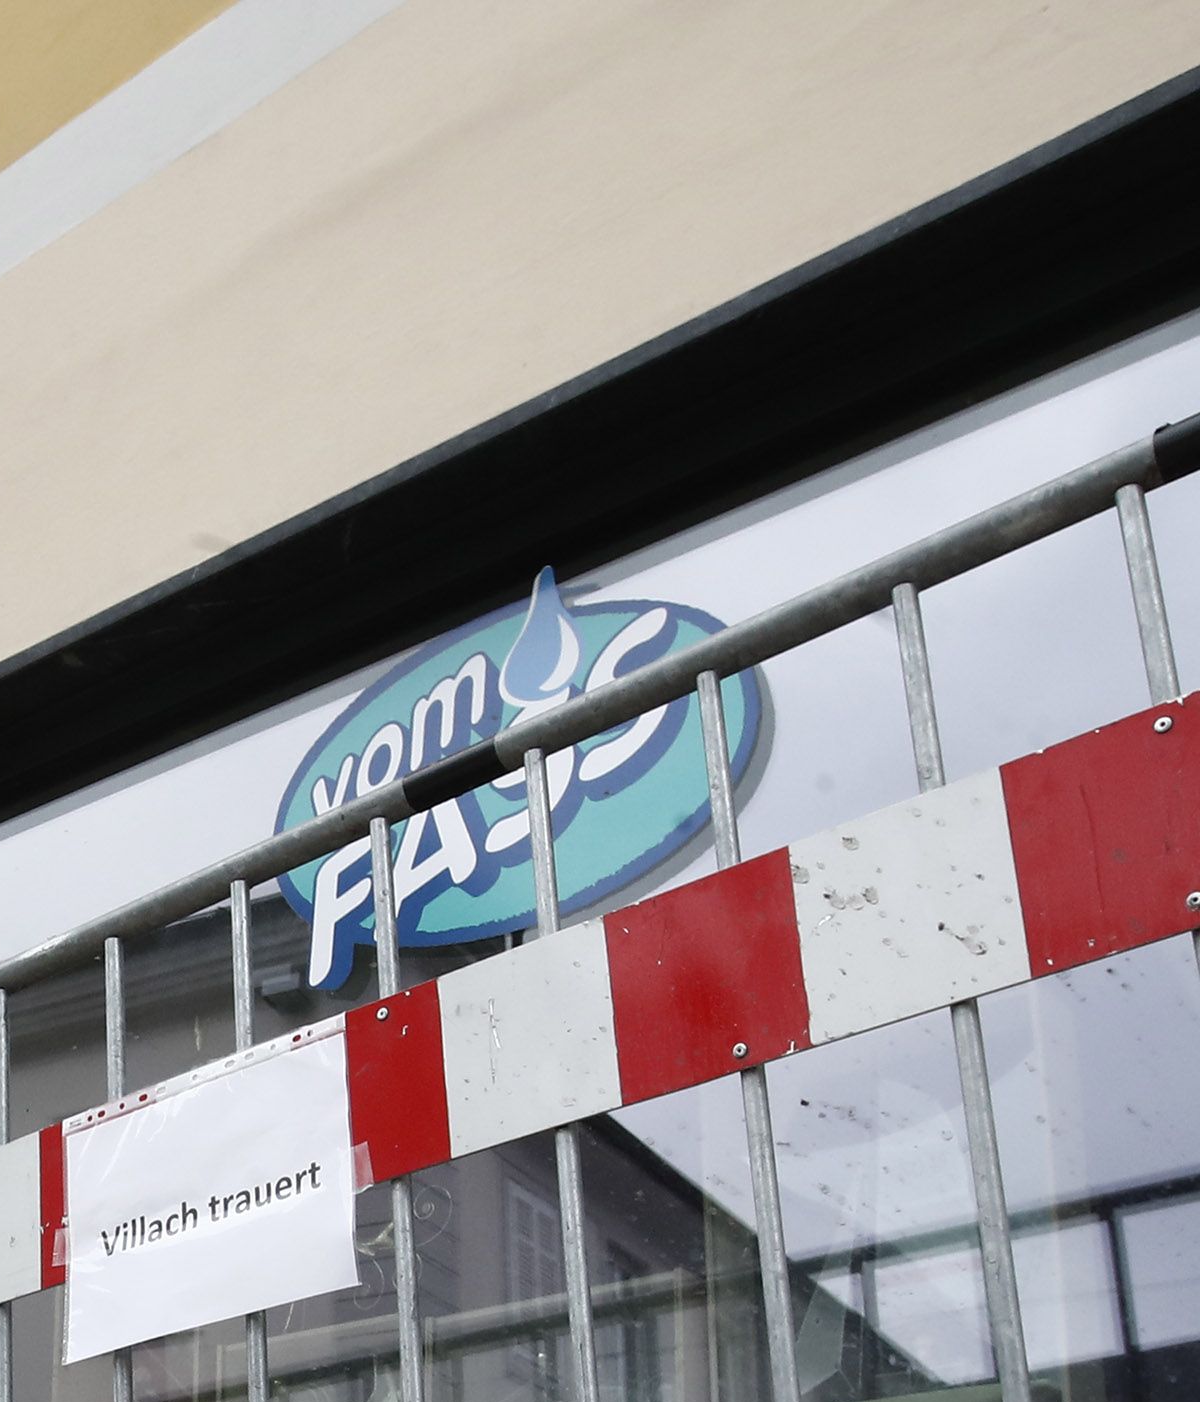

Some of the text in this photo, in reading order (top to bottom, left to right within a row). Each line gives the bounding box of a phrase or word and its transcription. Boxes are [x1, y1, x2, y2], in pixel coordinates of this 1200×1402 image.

[311, 652, 487, 809] vom
[100, 1161, 322, 1257] Villach trauert
